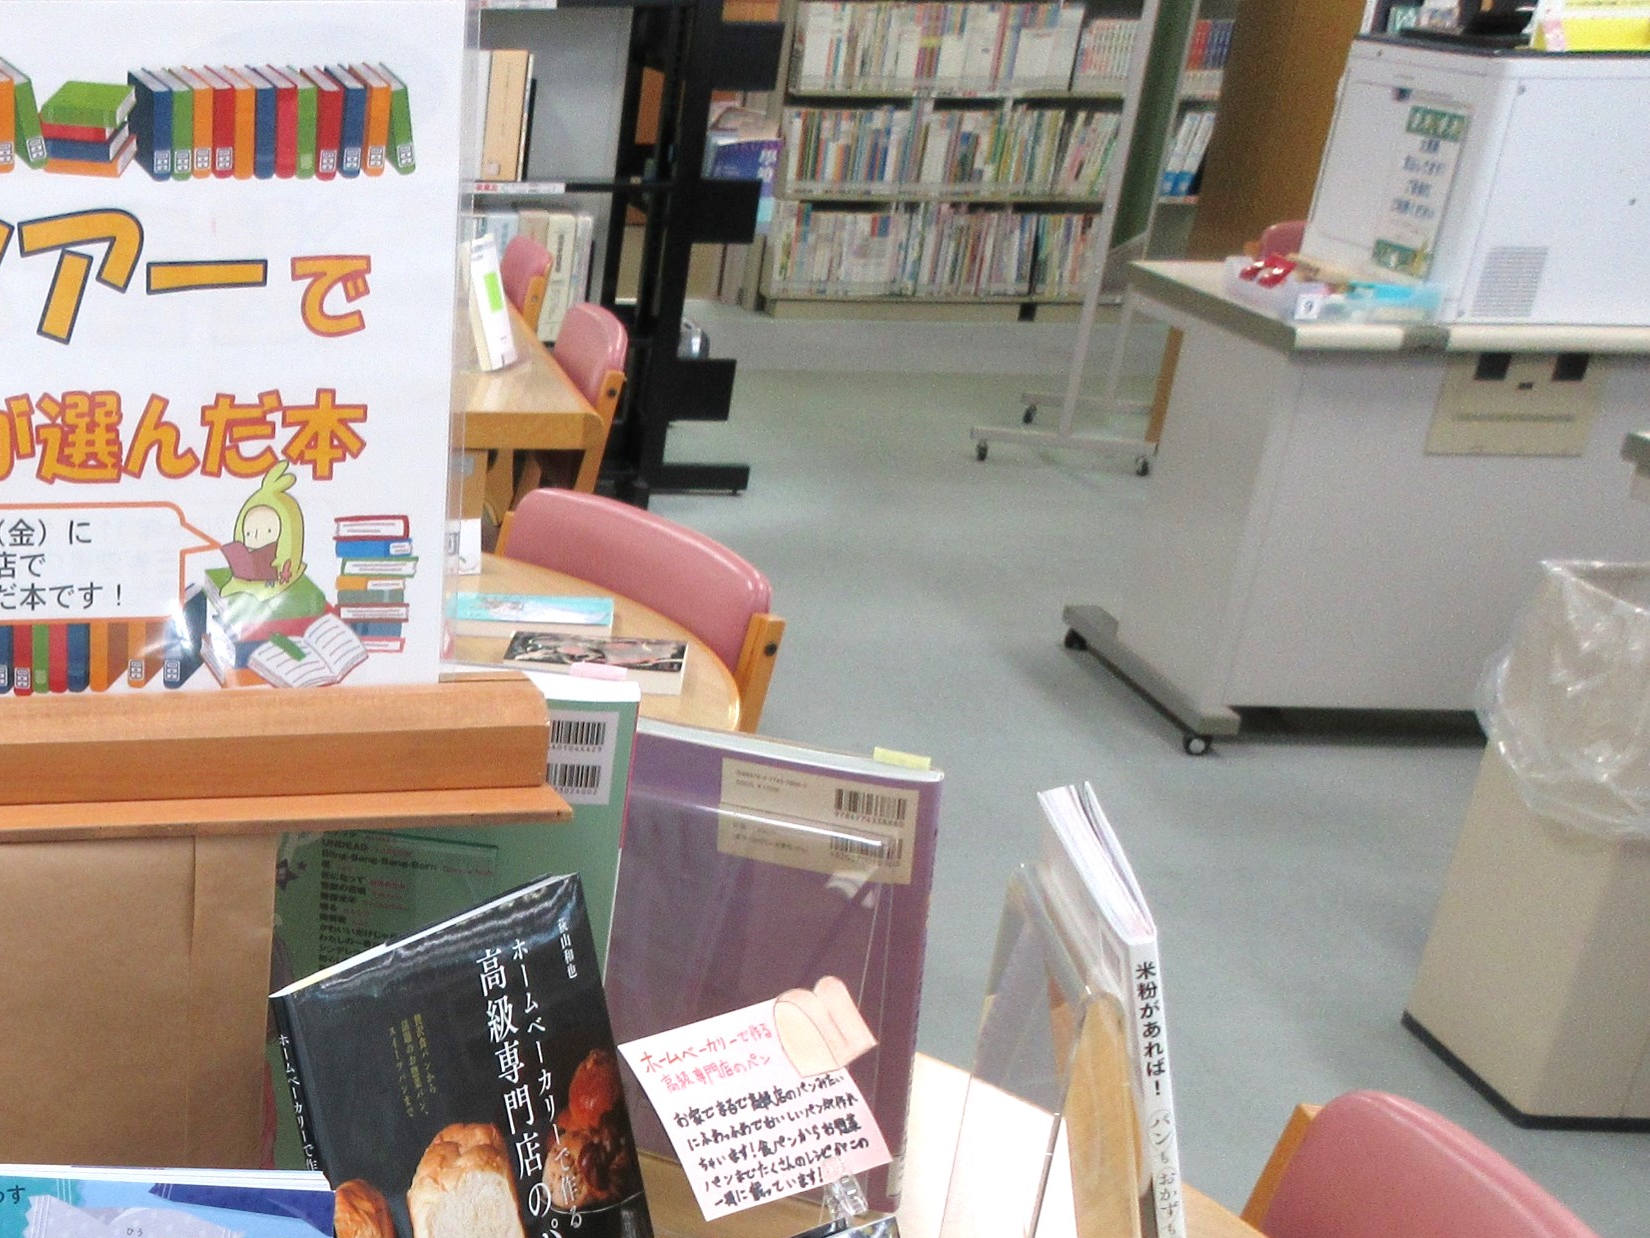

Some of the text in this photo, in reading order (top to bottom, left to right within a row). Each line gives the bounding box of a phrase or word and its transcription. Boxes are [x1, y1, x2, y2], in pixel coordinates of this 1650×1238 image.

[511, 938, 582, 1229] ホームベーカリーで作る
